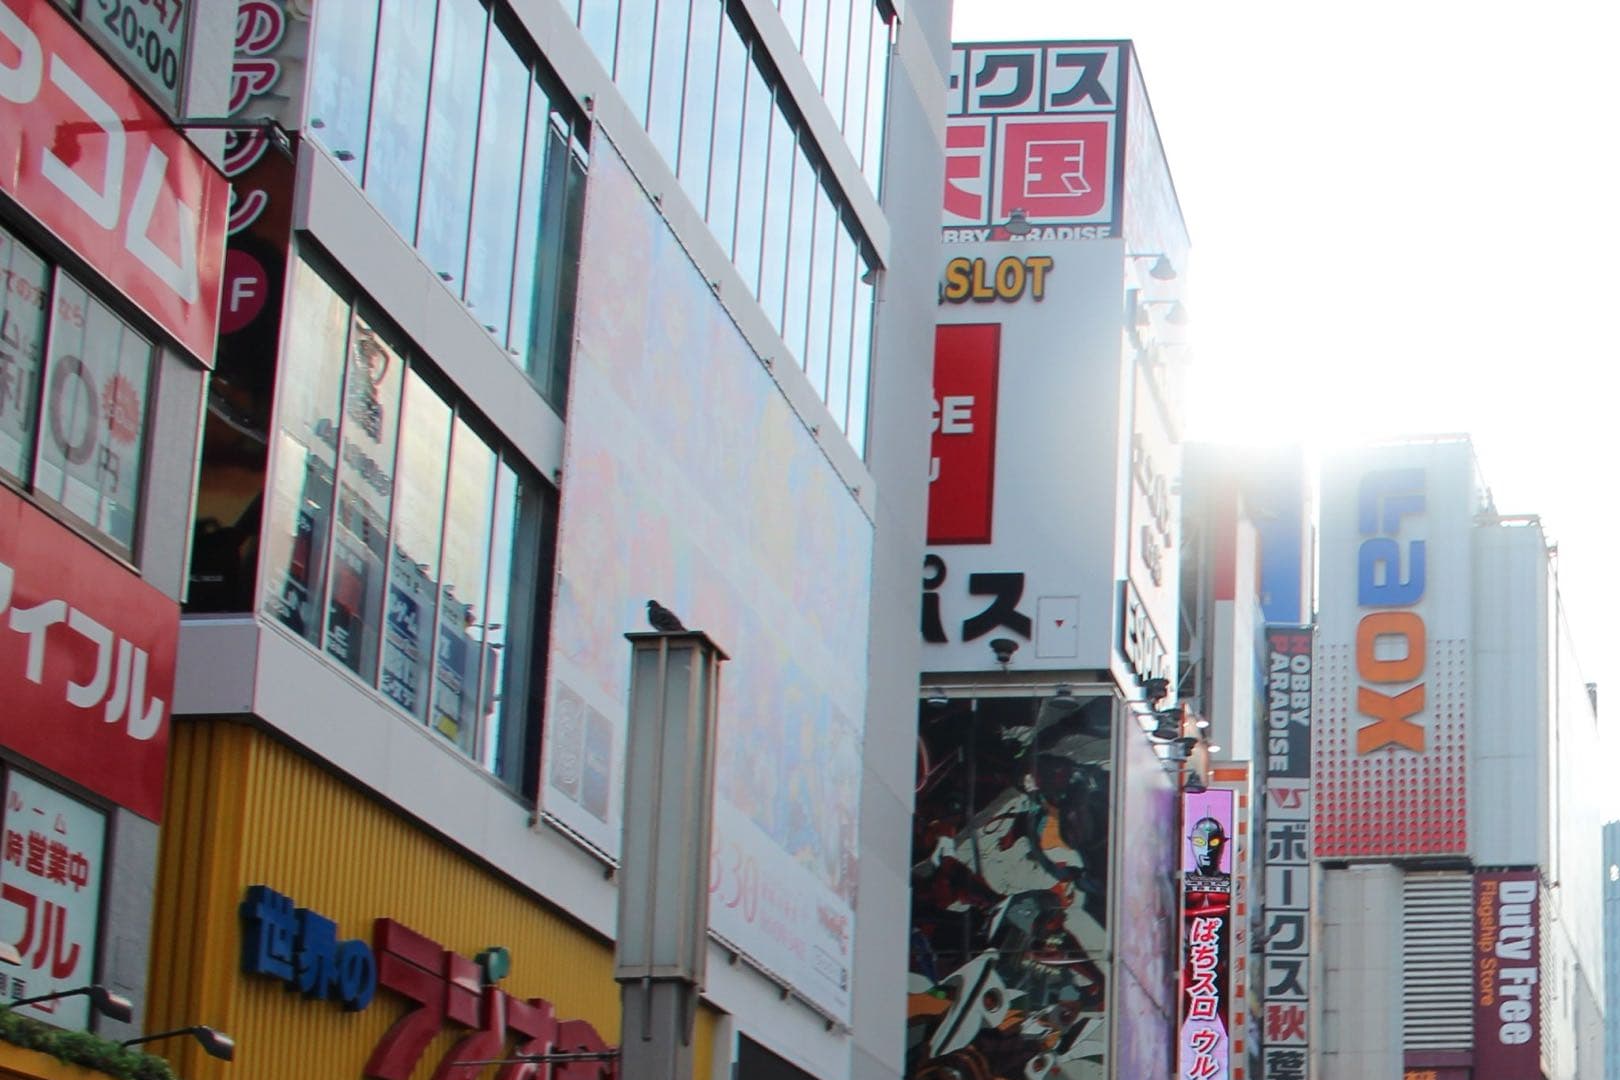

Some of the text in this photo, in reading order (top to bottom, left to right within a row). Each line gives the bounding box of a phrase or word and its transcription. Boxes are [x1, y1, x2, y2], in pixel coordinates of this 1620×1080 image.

[950, 52, 1113, 110] クス
[945, 256, 1053, 304] SLOT
[0, 562, 165, 740] イフル
[1268, 635, 1290, 773] PARADISE
[1290, 635, 1311, 727] HOBBY
[1189, 917, 1222, 1021] ぱちスロ
[1476, 880, 1498, 1007] Flagship Store
[1495, 880, 1538, 1046] Duty Free
